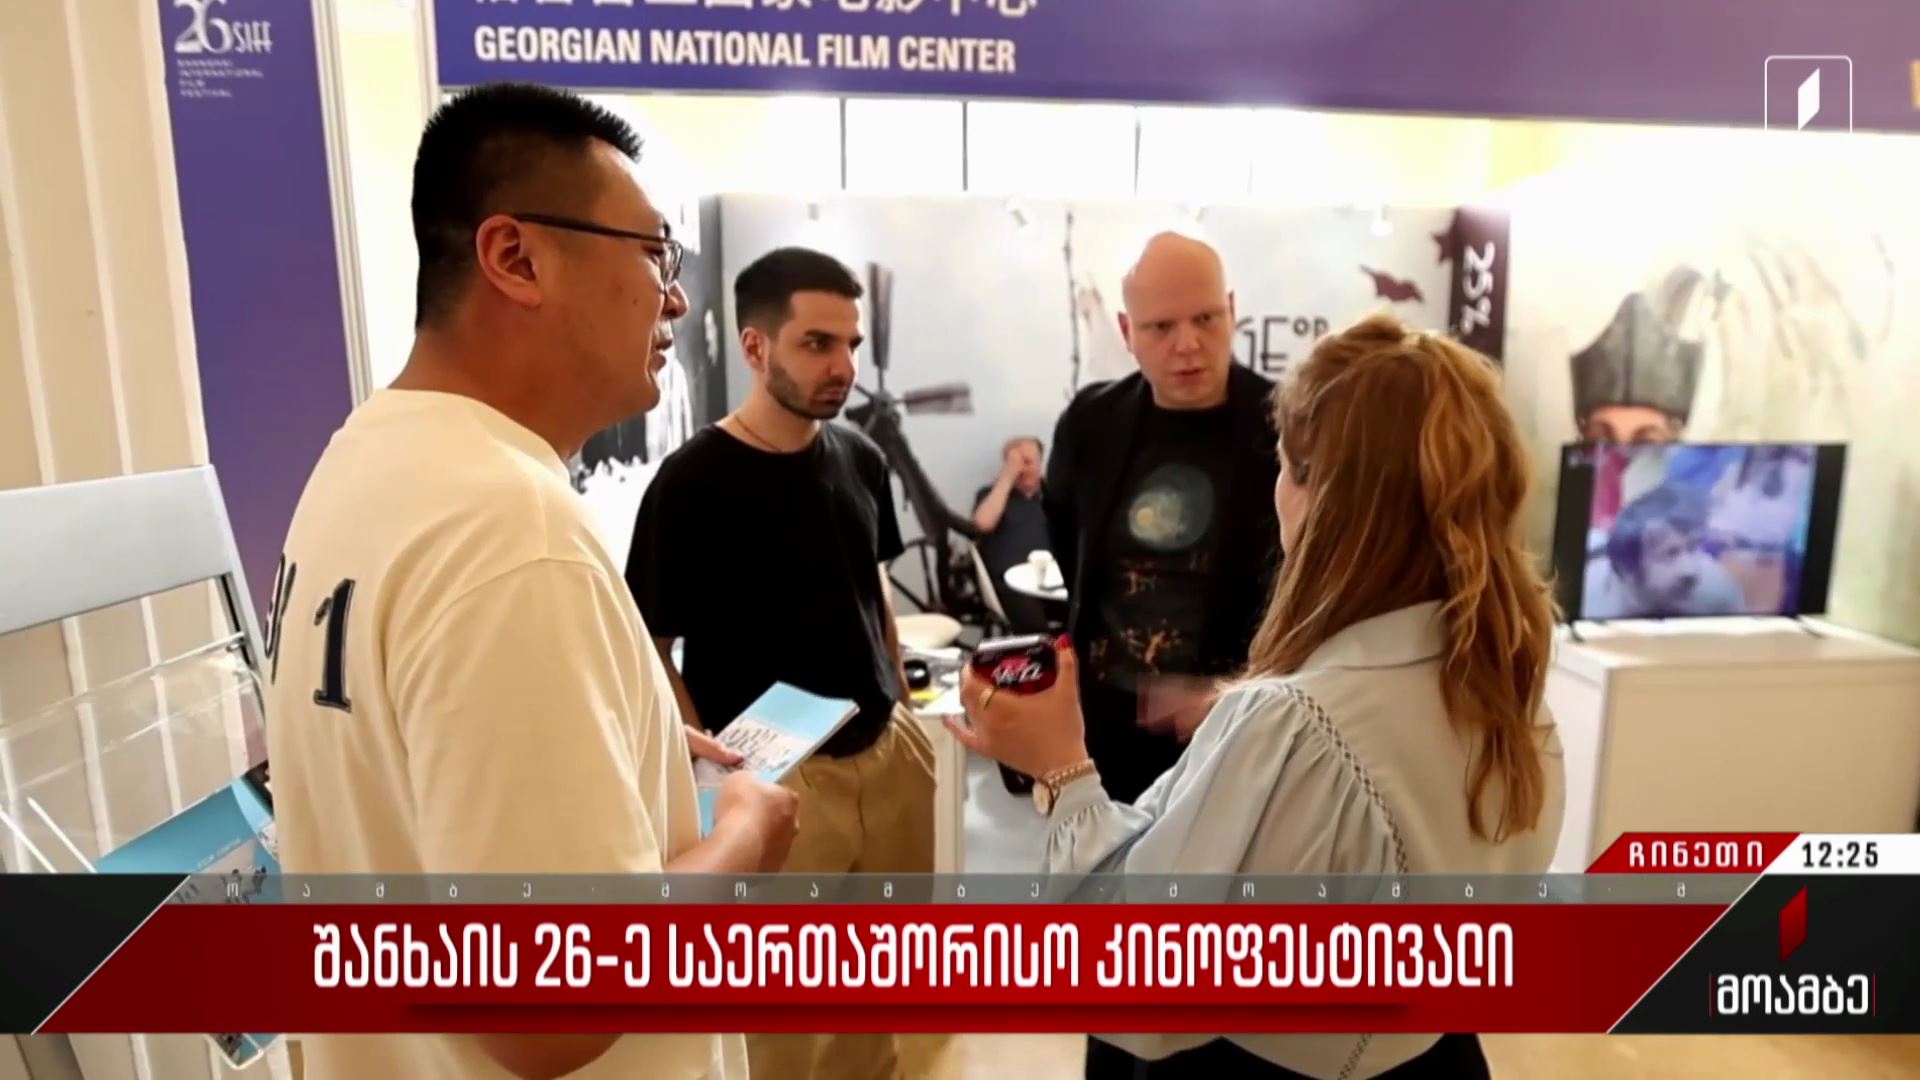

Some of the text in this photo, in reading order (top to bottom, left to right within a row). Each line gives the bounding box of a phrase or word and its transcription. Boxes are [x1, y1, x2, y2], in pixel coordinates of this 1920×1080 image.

[474, 25, 1016, 73] GEORGIAN NATIONAL FILM CENTER
